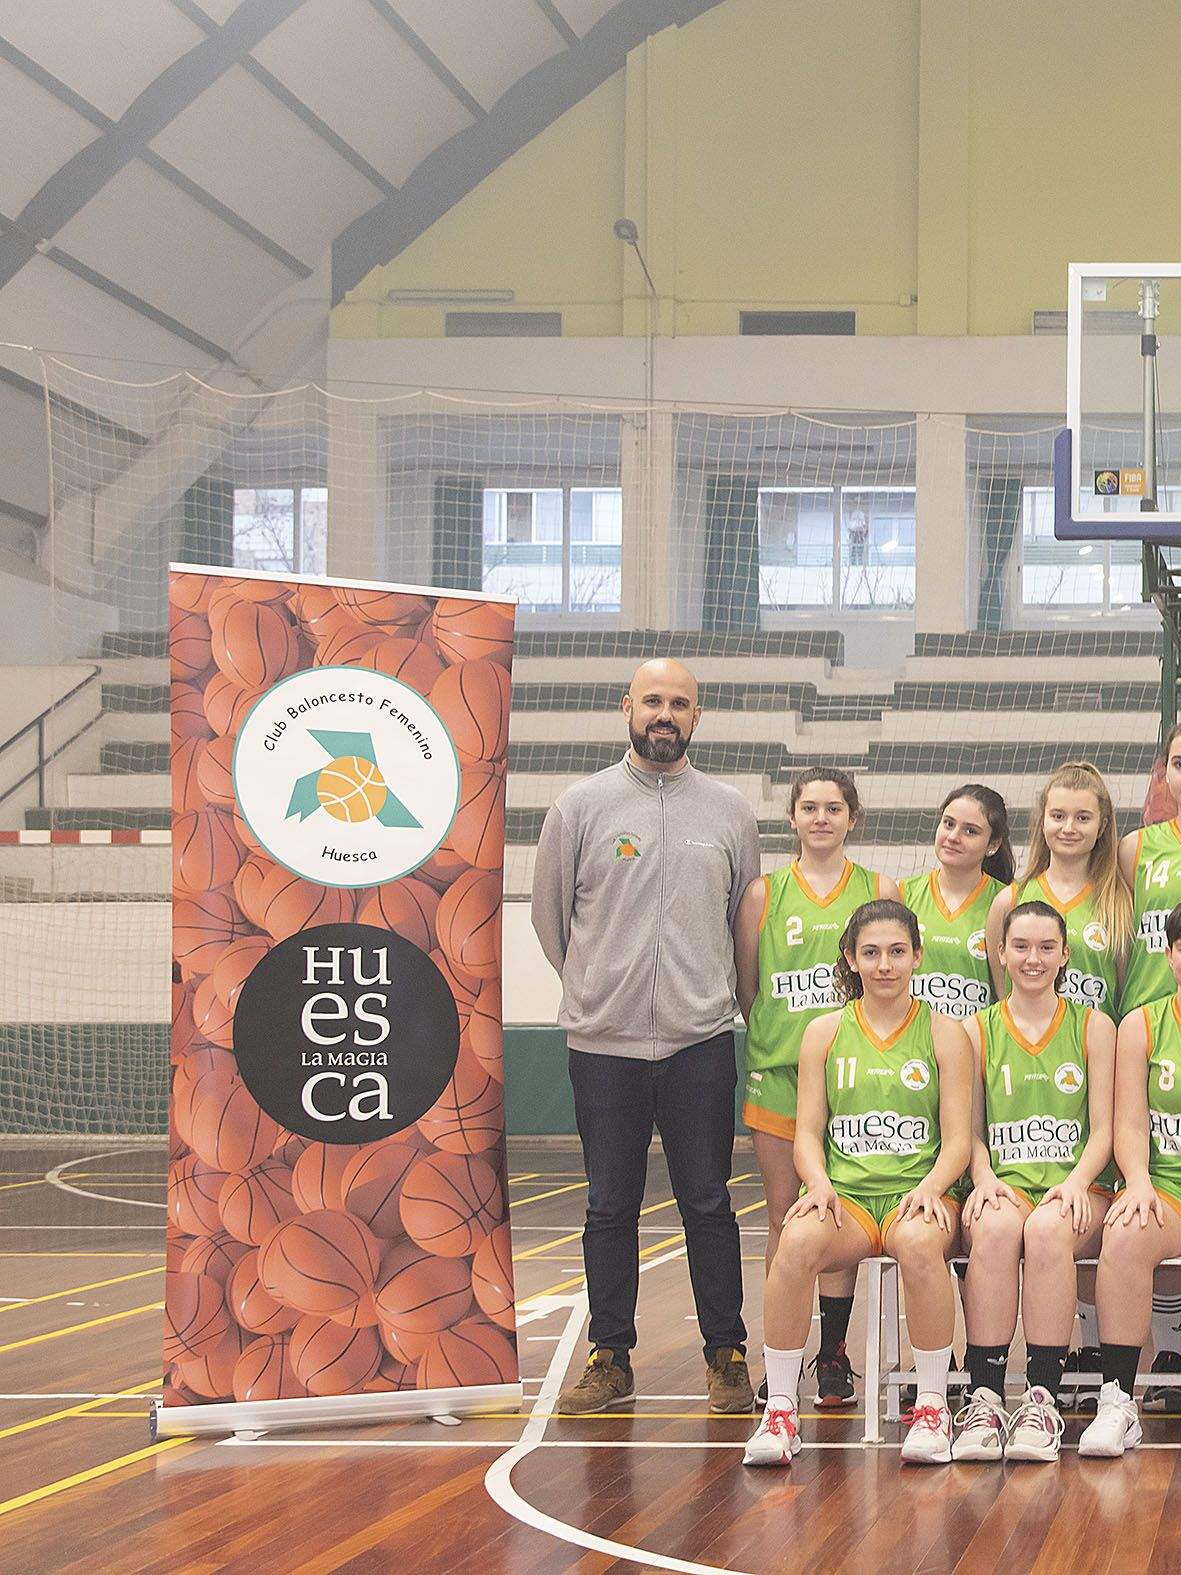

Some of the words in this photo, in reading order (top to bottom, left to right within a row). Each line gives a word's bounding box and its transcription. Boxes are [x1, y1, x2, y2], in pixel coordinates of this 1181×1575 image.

[264, 719, 288, 752] Club
[287, 691, 374, 720] Baloncesto
[379, 698, 433, 761] Femenino
[321, 845, 378, 862] Huesca
[1144, 859, 1170, 891] 14
[786, 916, 804, 946] 2
[776, 967, 831, 994] Hue
[912, 976, 988, 1003] uesca
[835, 1056, 857, 1089] 11
[1000, 1063, 1013, 1096] 1
[1158, 1059, 1176, 1092] 8
[831, 1115, 926, 1140] Huesca
[992, 1119, 1080, 1146] Huesca
